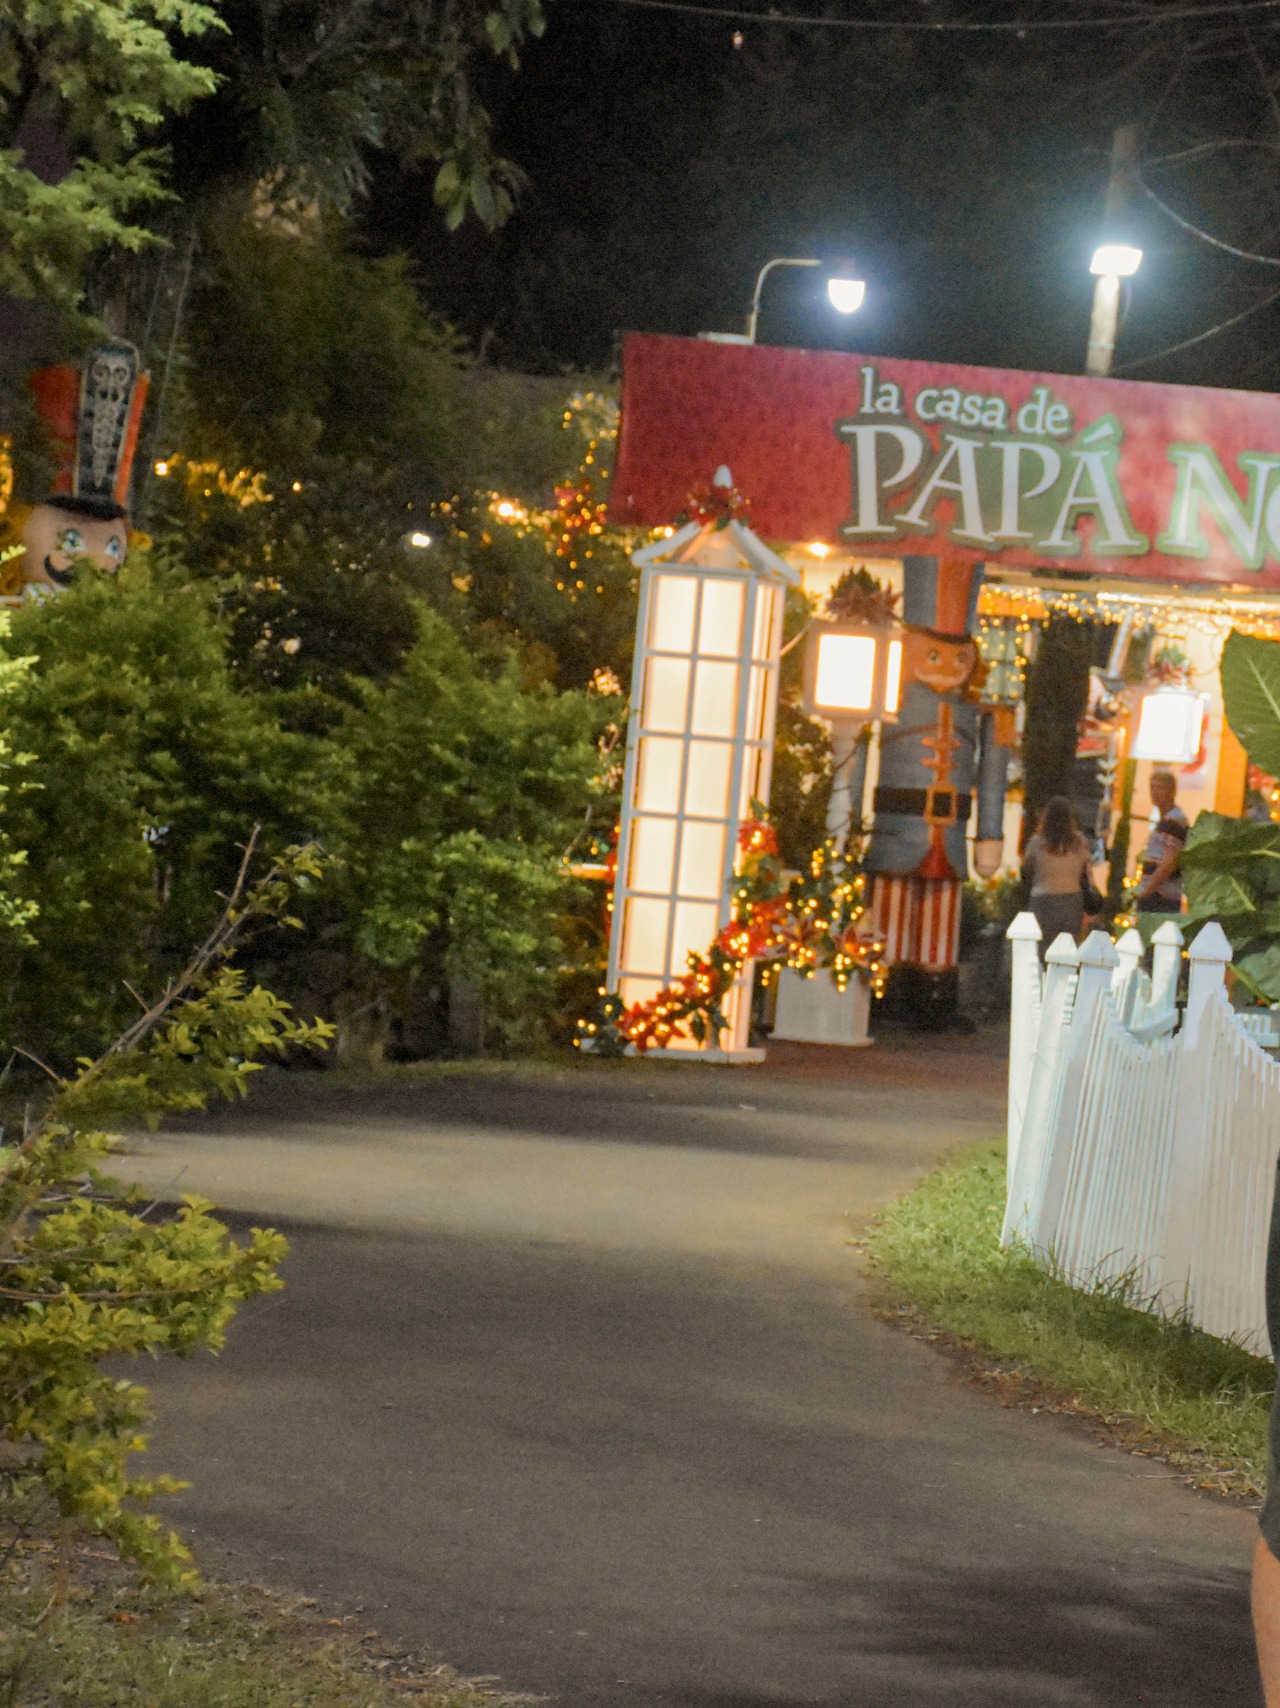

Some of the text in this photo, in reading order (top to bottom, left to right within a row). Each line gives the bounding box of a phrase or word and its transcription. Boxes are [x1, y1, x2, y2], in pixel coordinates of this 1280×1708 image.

[860, 367, 1070, 435] la casa de
[841, 422, 1142, 547] PAPÁ
